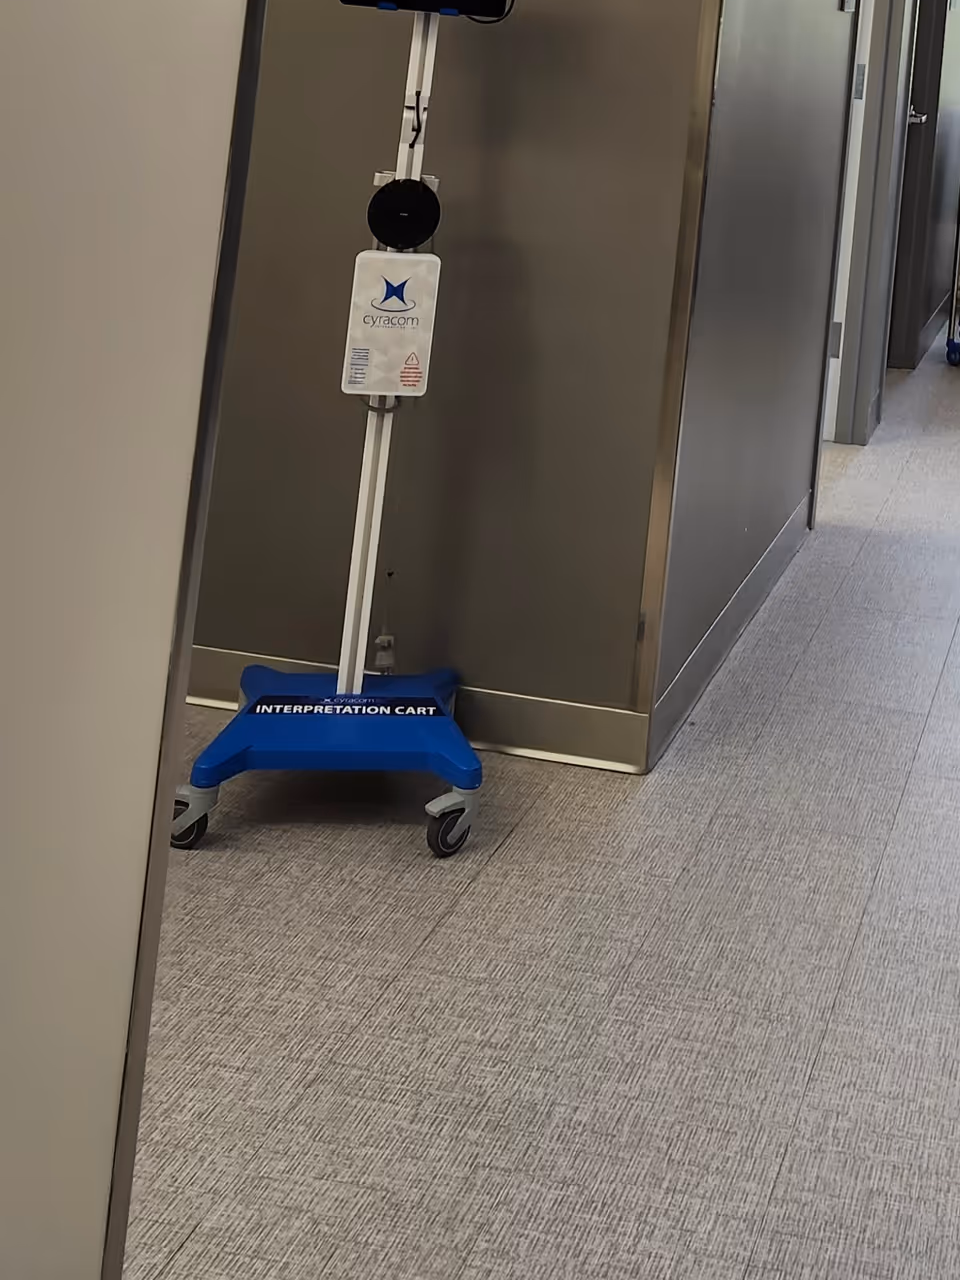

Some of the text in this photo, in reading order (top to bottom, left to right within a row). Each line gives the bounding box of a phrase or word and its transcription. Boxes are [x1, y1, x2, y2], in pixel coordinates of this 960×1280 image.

[363, 314, 419, 327] cyracom
[255, 704, 437, 716] INTERPRETATION CART
